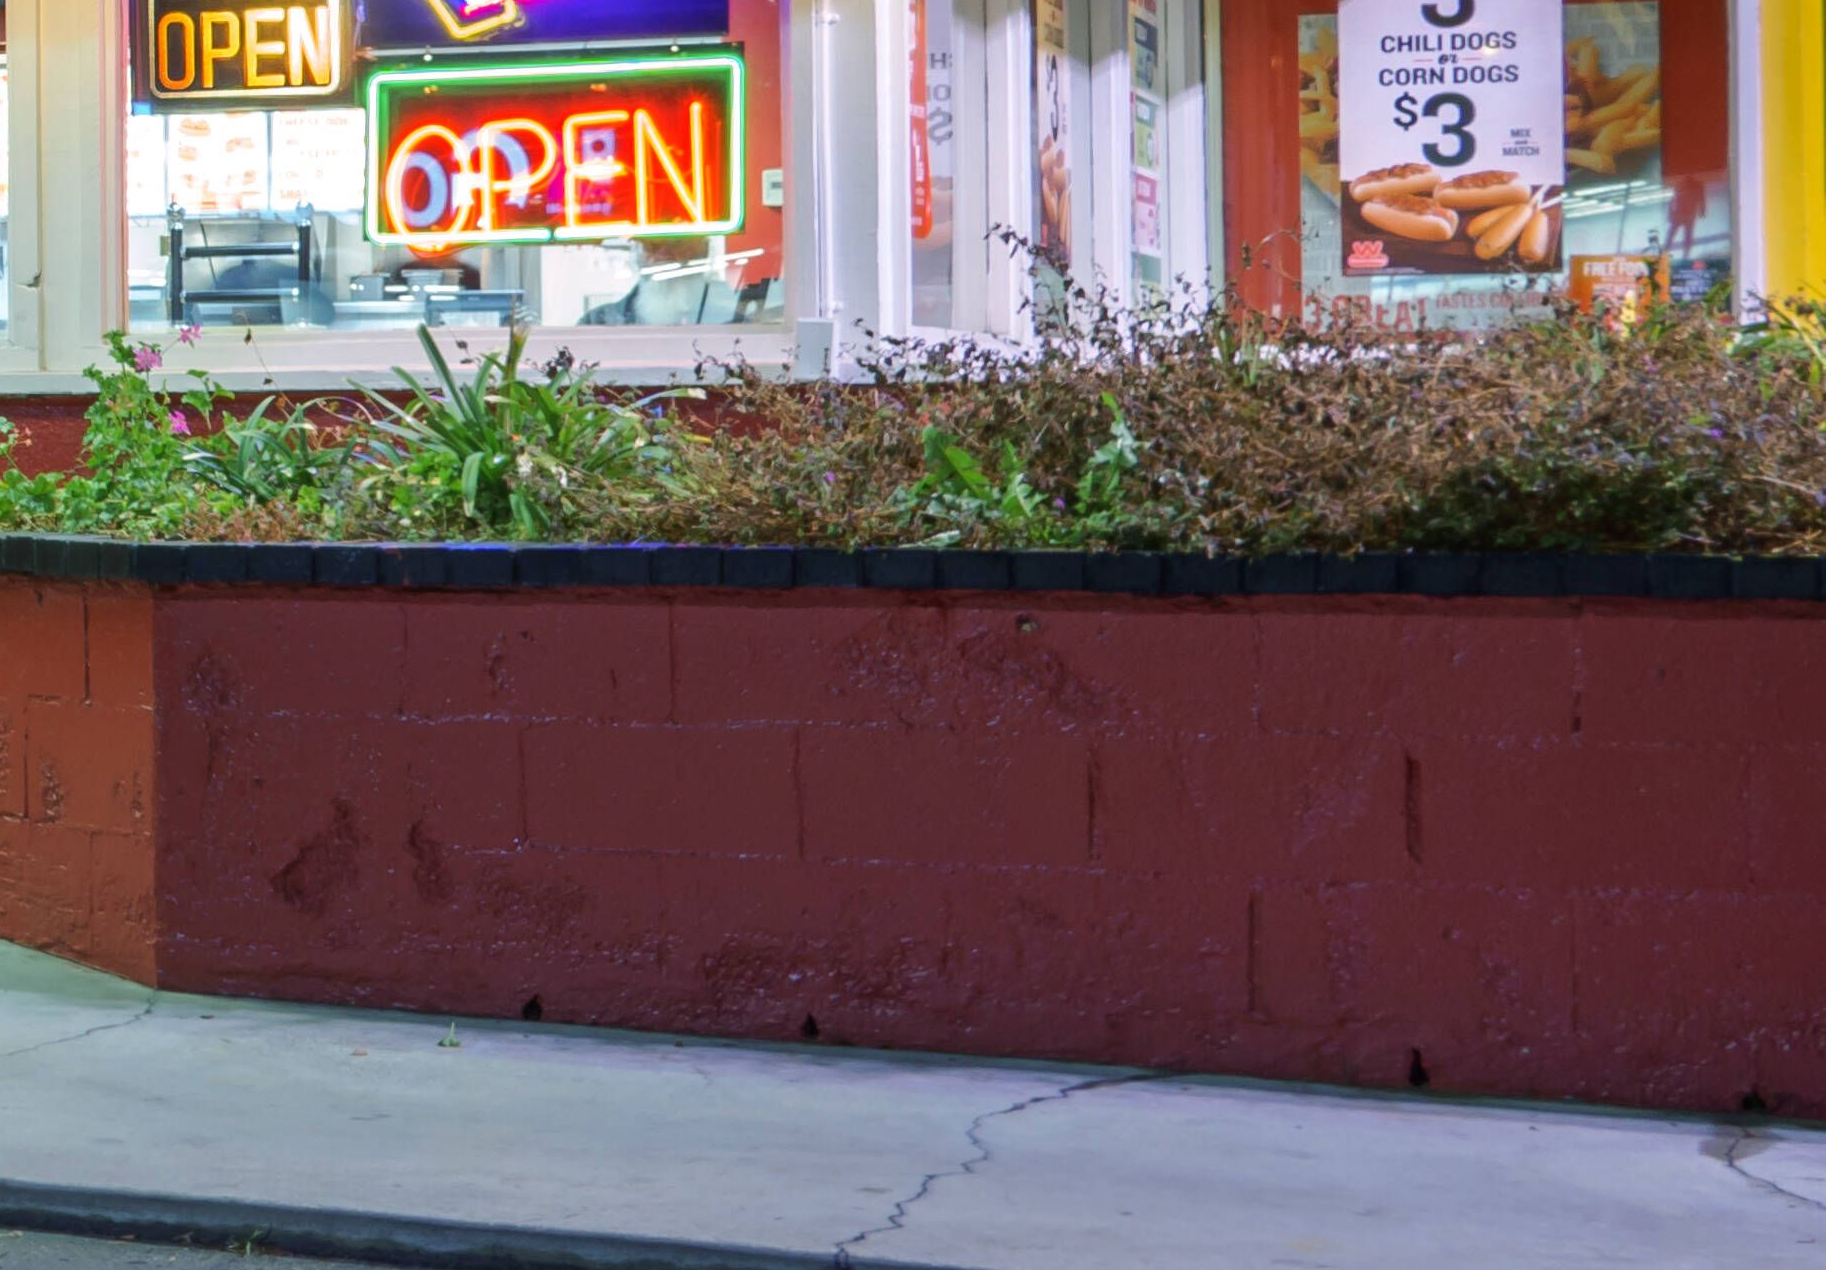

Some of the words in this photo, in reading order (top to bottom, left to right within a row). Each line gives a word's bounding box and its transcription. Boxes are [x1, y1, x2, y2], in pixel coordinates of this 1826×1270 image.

[157, 5, 331, 91] OPEN
[1380, 34, 1443, 54] CHILI
[1450, 31, 1518, 51] DOGS
[1437, 53, 1460, 65] or
[1378, 66, 1445, 87] CORN
[1452, 64, 1520, 85] DOGS
[1509, 129, 1532, 138] MIX
[1502, 146, 1540, 156] MATCH
[385, 101, 707, 250] OPEN
